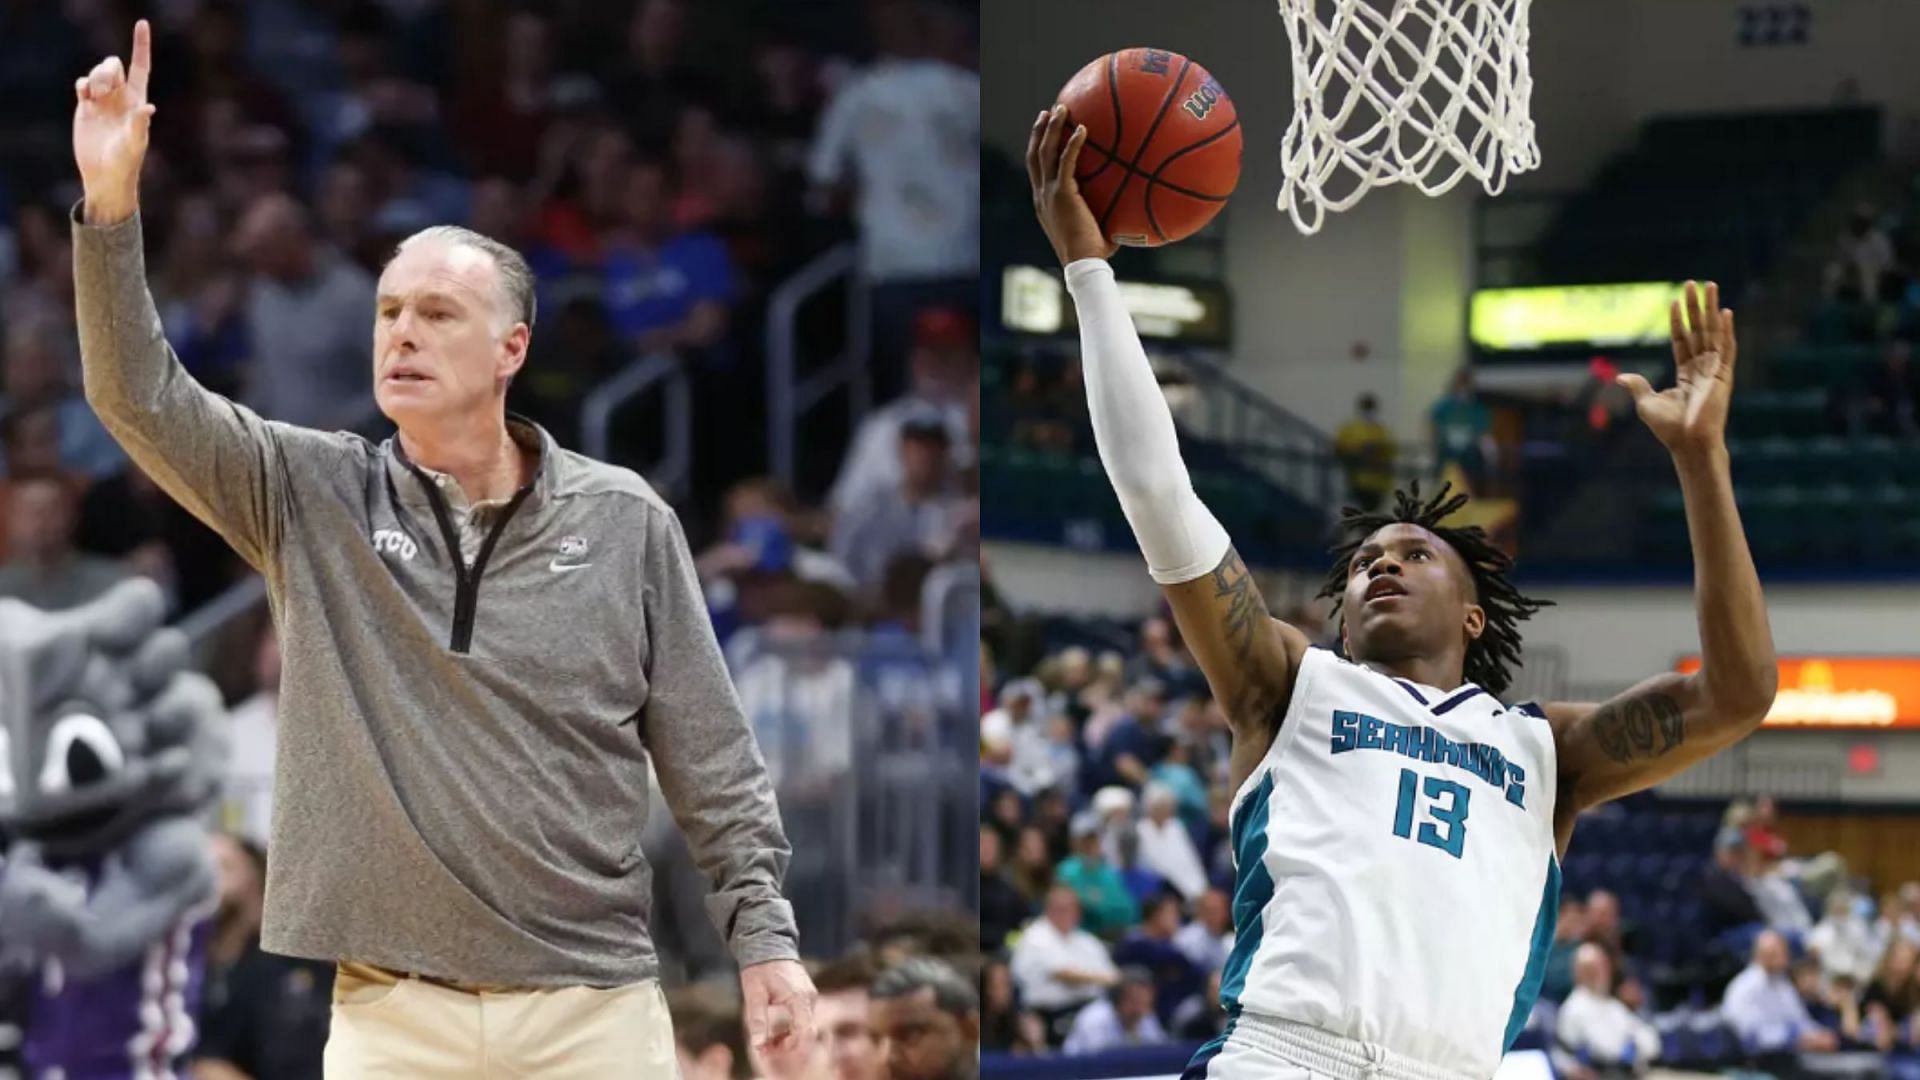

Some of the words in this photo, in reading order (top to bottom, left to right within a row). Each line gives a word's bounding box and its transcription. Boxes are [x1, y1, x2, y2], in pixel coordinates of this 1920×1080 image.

[372, 529, 418, 561] TCU
[1331, 709, 1526, 810] SEAHAWKS
[1393, 768, 1472, 860] 13
